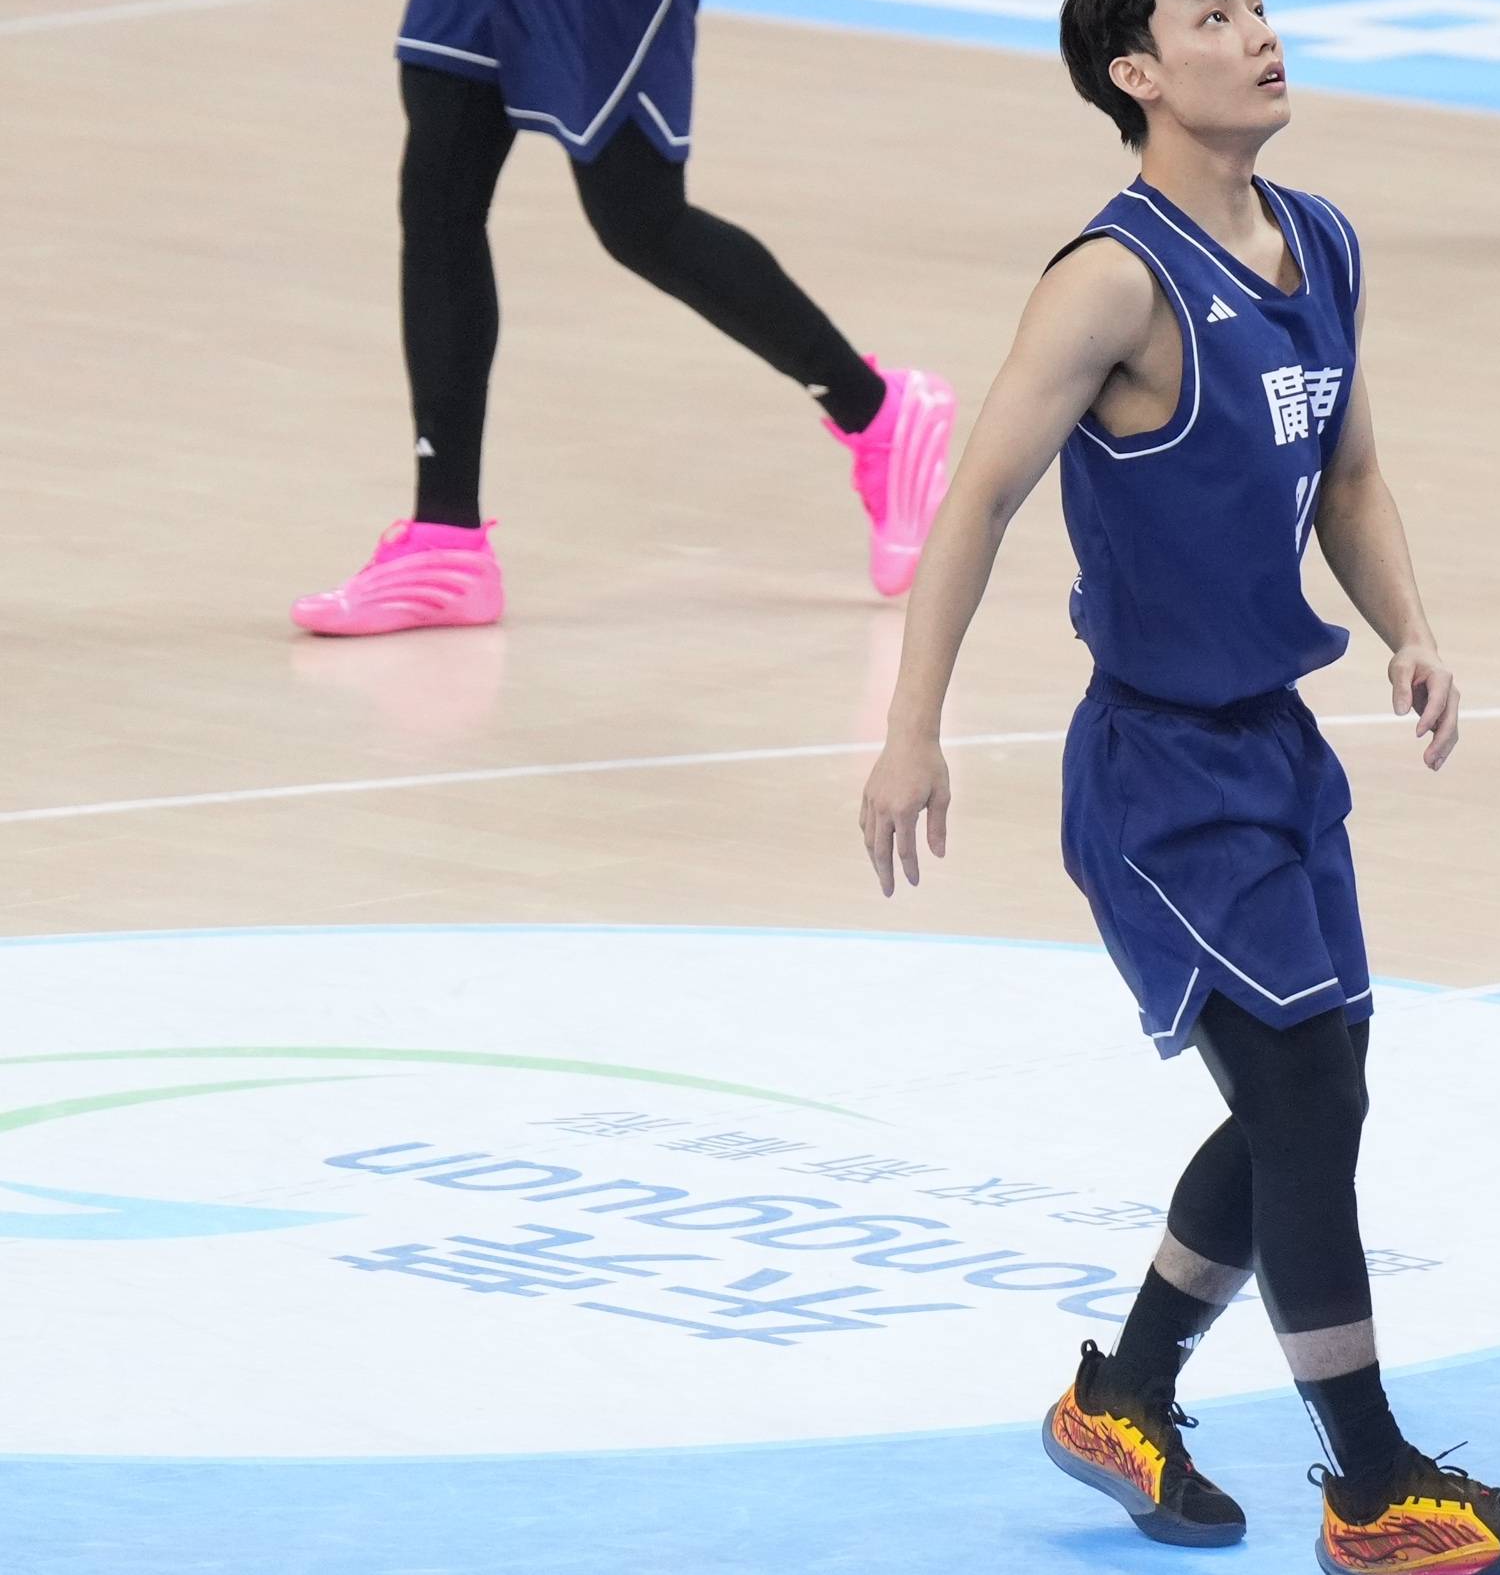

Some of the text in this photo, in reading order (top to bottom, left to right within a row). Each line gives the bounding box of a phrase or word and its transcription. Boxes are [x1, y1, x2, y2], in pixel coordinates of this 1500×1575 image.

[529, 1110, 1443, 1277] 每绽放新精彩
[331, 1222, 976, 1348] 东莞
